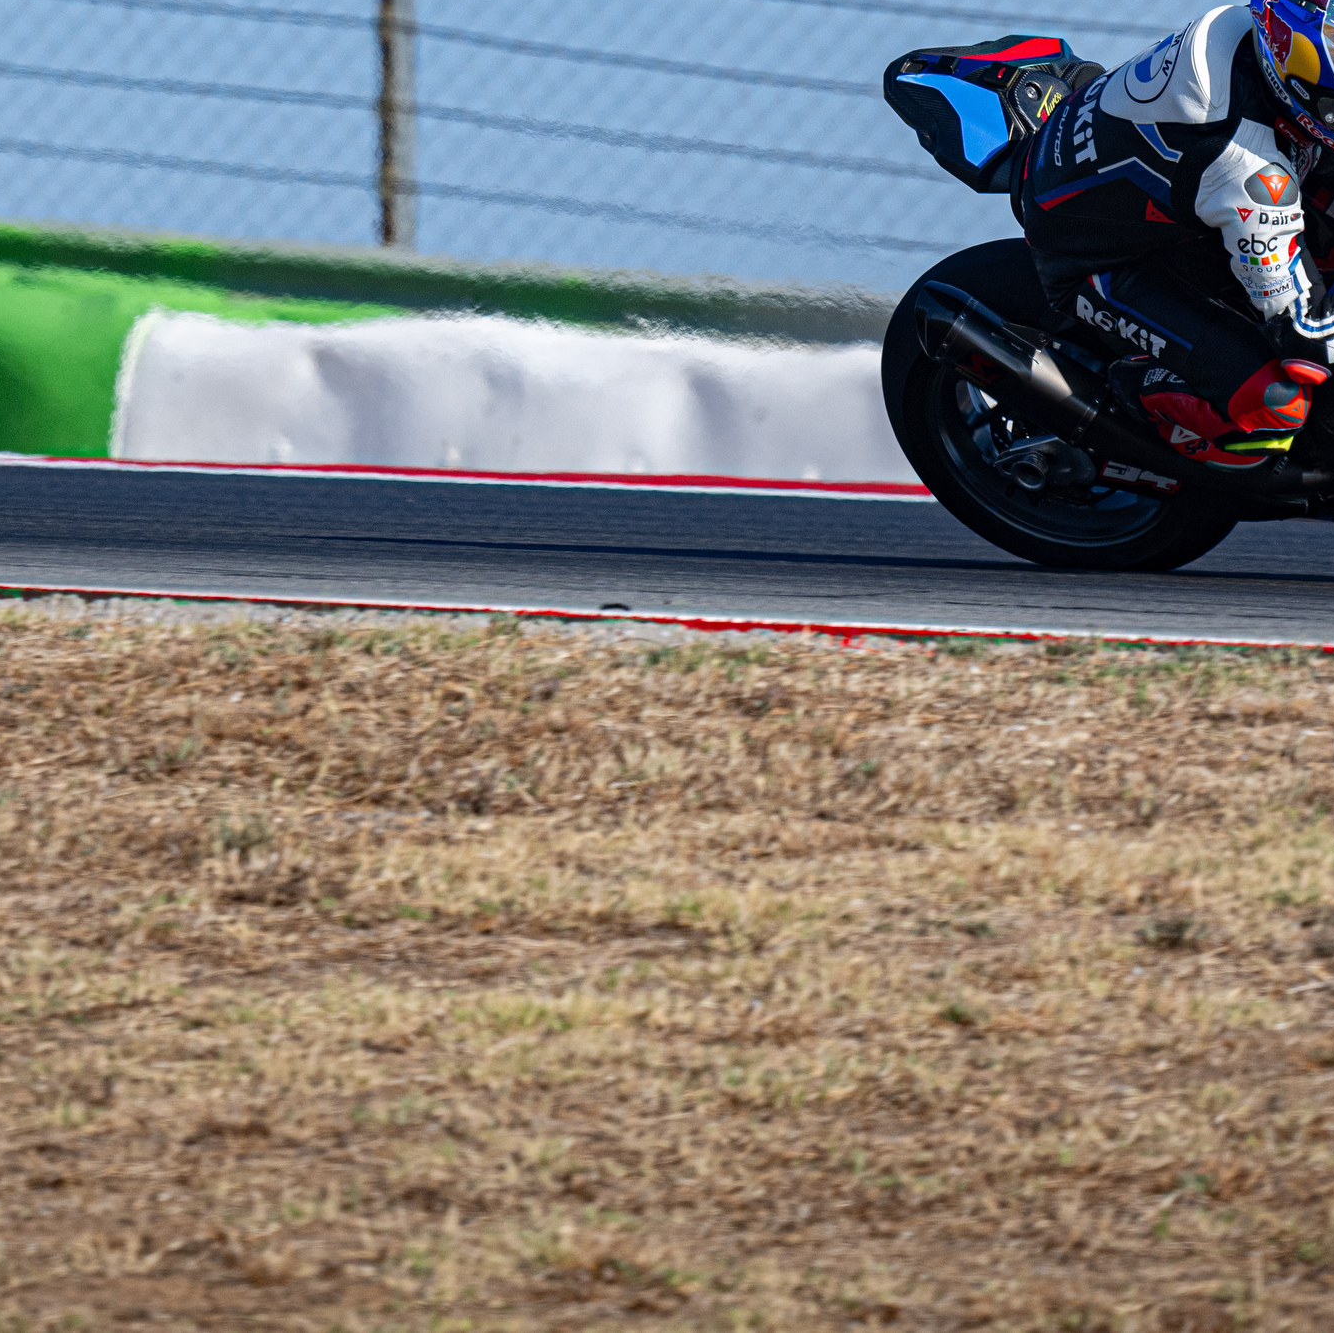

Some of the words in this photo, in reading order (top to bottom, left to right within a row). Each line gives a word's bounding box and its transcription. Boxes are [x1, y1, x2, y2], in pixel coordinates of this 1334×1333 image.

[1265, 66, 1288, 102] SHOEI
[1054, 105, 1070, 167] OUTDO
[1237, 234, 1278, 255] ebc
[1242, 263, 1281, 273] group
[1269, 284, 1289, 296] PVM
